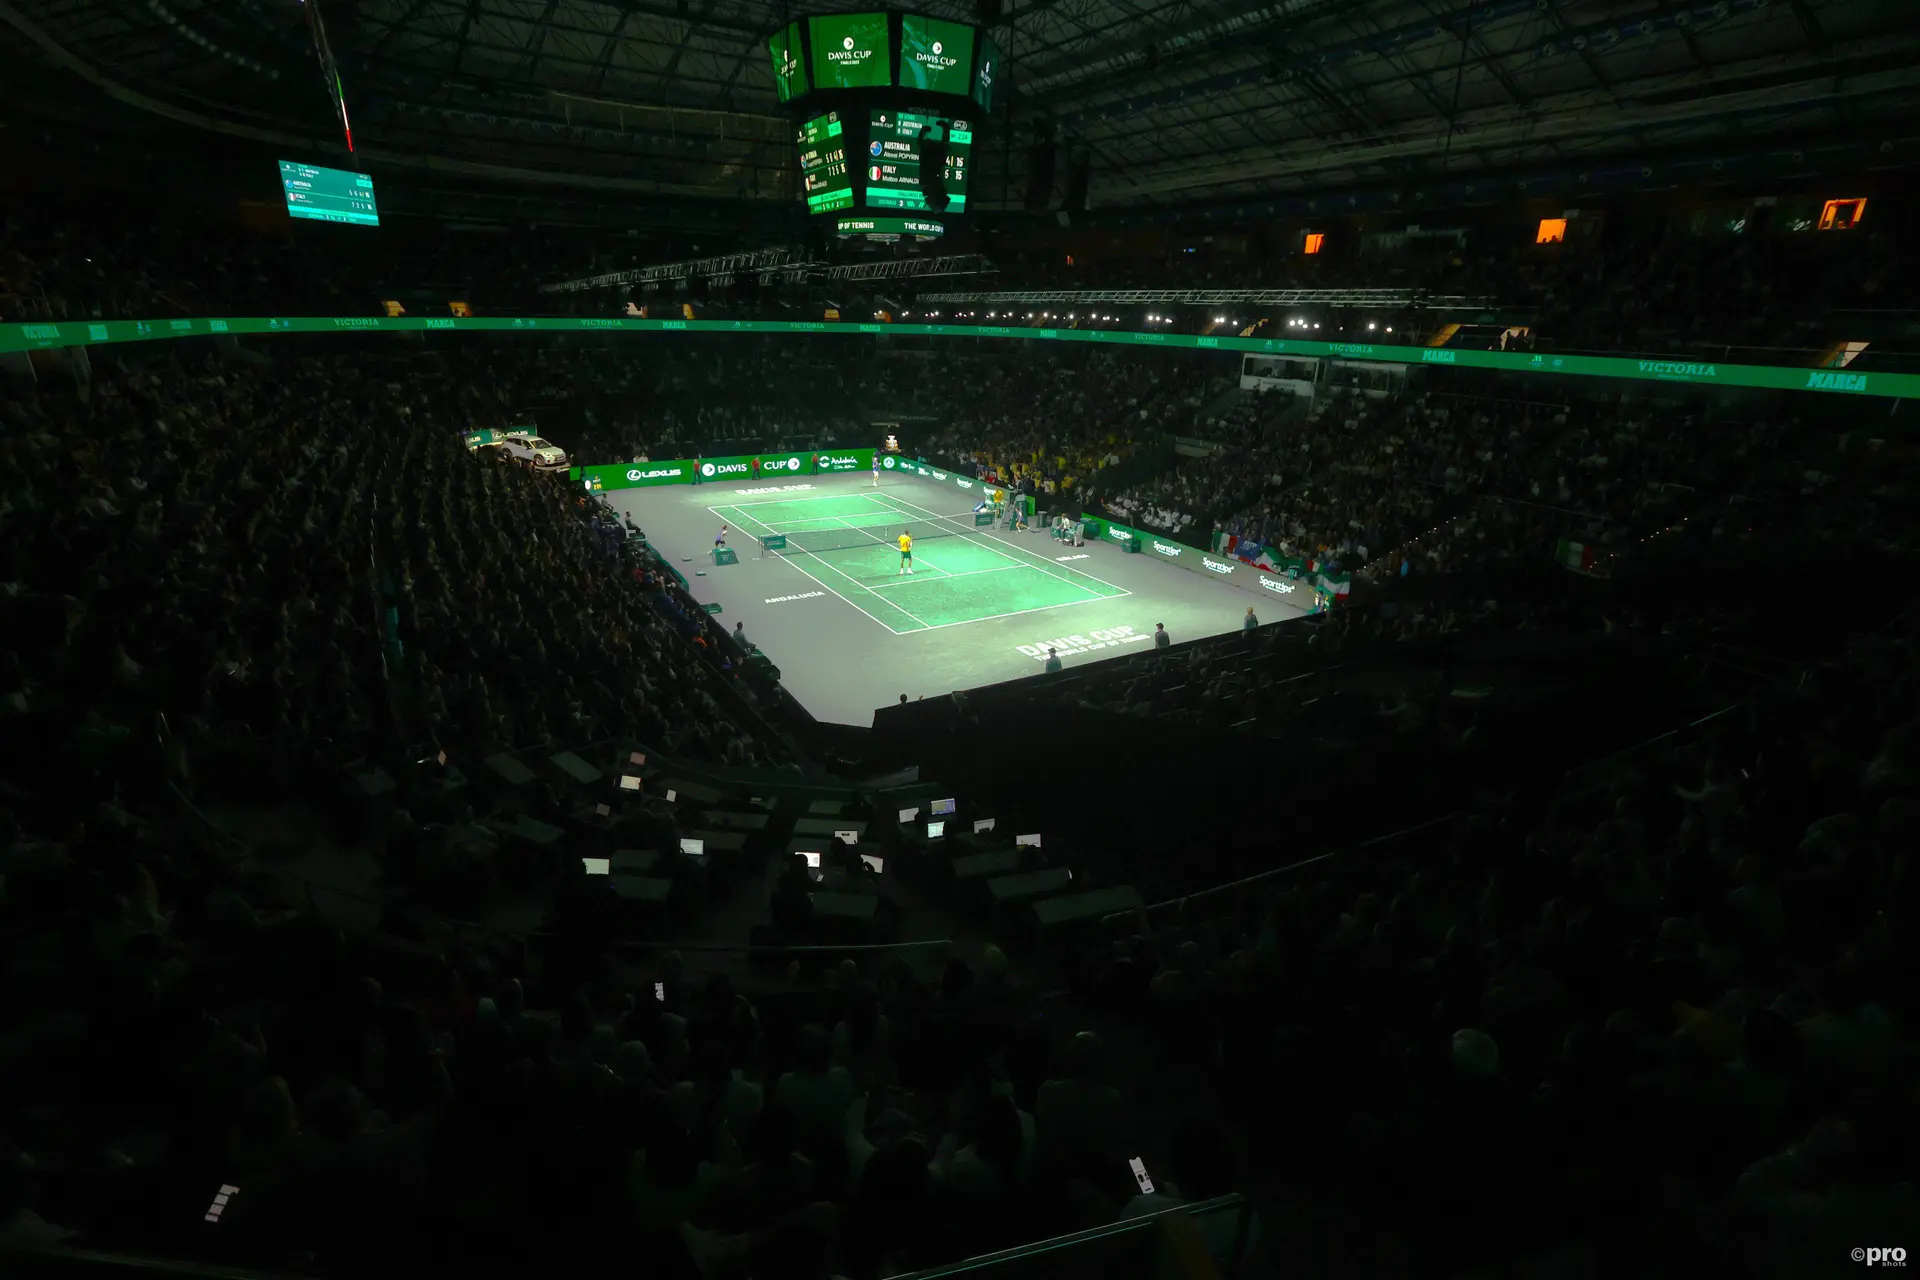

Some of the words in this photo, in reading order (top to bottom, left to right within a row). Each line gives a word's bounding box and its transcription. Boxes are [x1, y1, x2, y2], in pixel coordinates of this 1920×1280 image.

[828, 51, 852, 60] DAVIS
[853, 50, 872, 59] CUP
[916, 53, 938, 63] DAVIS
[940, 56, 957, 66] CUP
[883, 141, 911, 151] AUSTRALIA
[945, 156, 950, 166] 4
[882, 165, 897, 174] ITALY
[955, 170, 963, 180] 15
[904, 222, 917, 230] THE
[334, 318, 380, 326] VICTORIA
[1329, 343, 1373, 353] VICTORIA
[1422, 350, 1456, 363] MARCA
[1638, 360, 1717, 376] VICTORIA
[1806, 372, 1867, 391] MARCA
[717, 463, 747, 473] DAVIS
[764, 461, 787, 470] CUP
[641, 468, 682, 478] LEXUS
[1203, 557, 1235, 573] Sporttips
[1259, 575, 1295, 593] Sporttips
[765, 591, 826, 604] ANDALUCÍA
[1016, 635, 1092, 656] DAVIS
[1089, 625, 1134, 641] CUP
